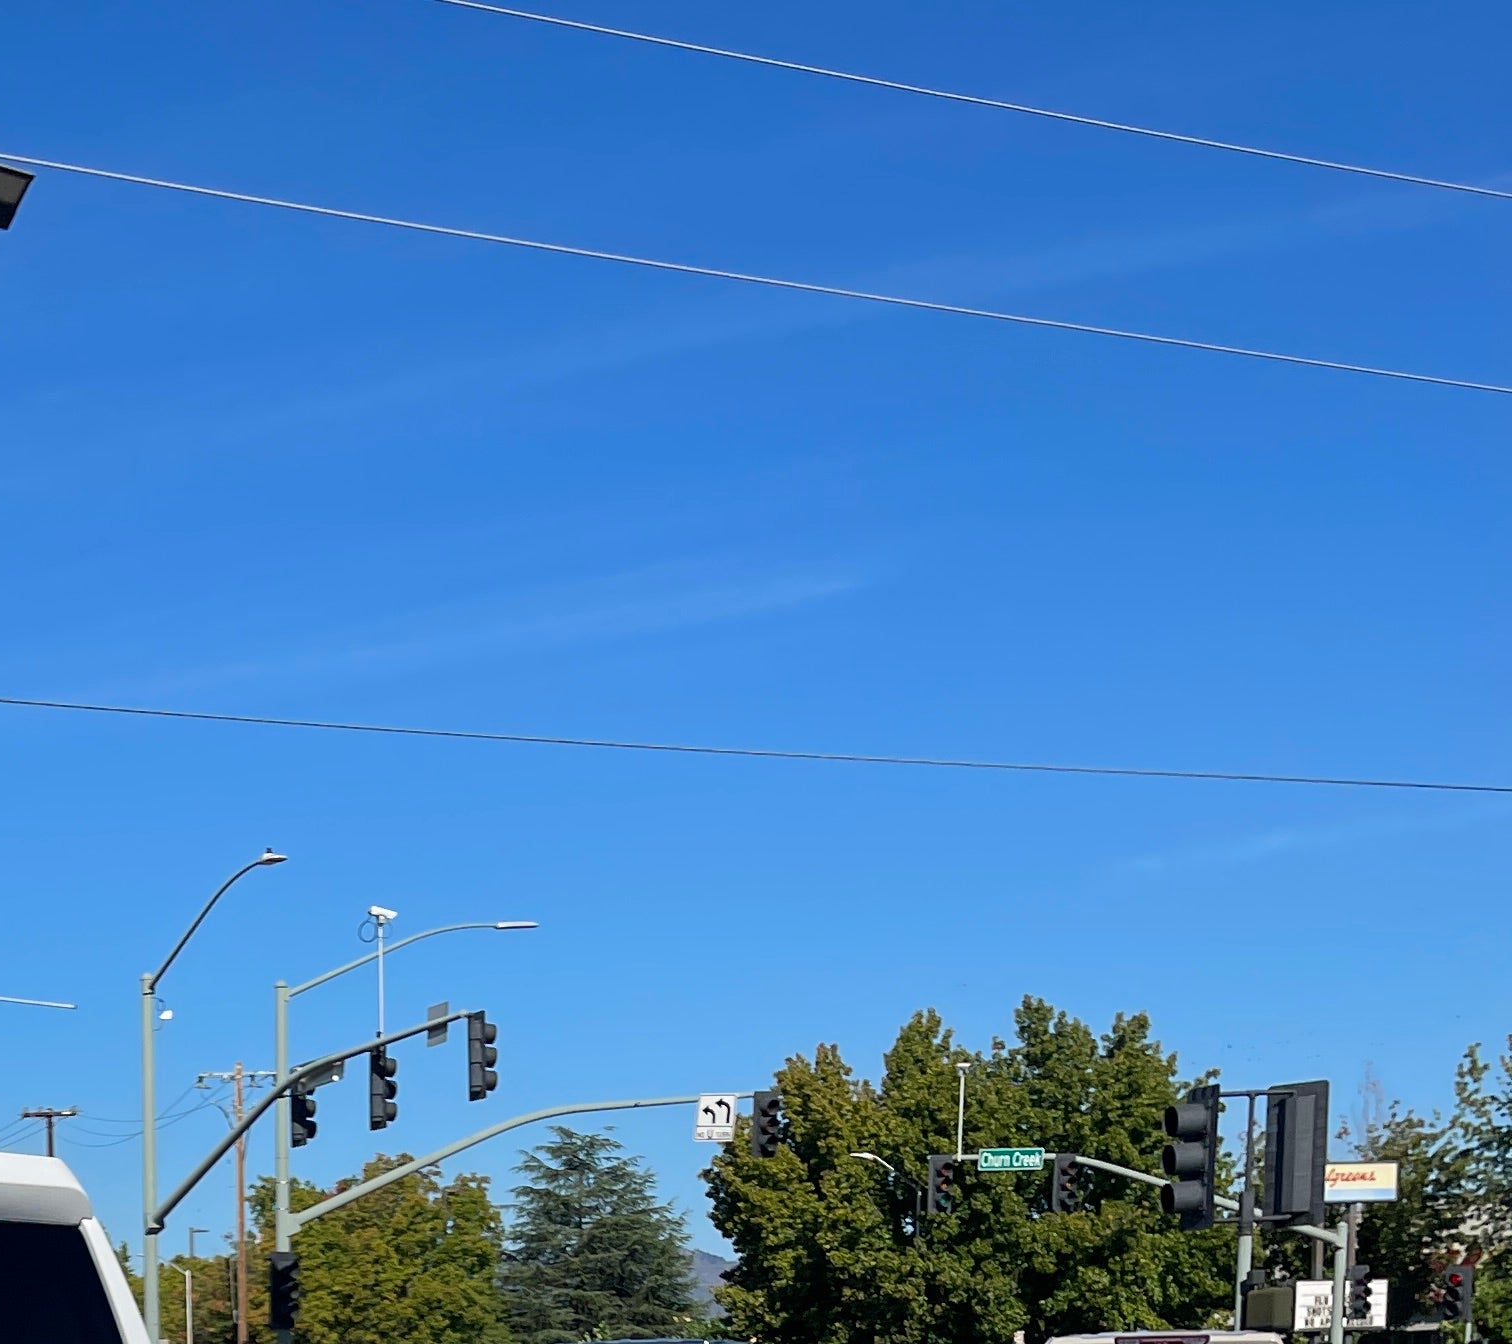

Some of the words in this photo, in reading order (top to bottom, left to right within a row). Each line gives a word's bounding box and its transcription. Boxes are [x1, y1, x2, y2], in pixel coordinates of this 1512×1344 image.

[981, 1152, 1011, 1167] Churn
[1012, 1151, 1042, 1167] Creek
[1324, 1167, 1377, 1188] lgreens
